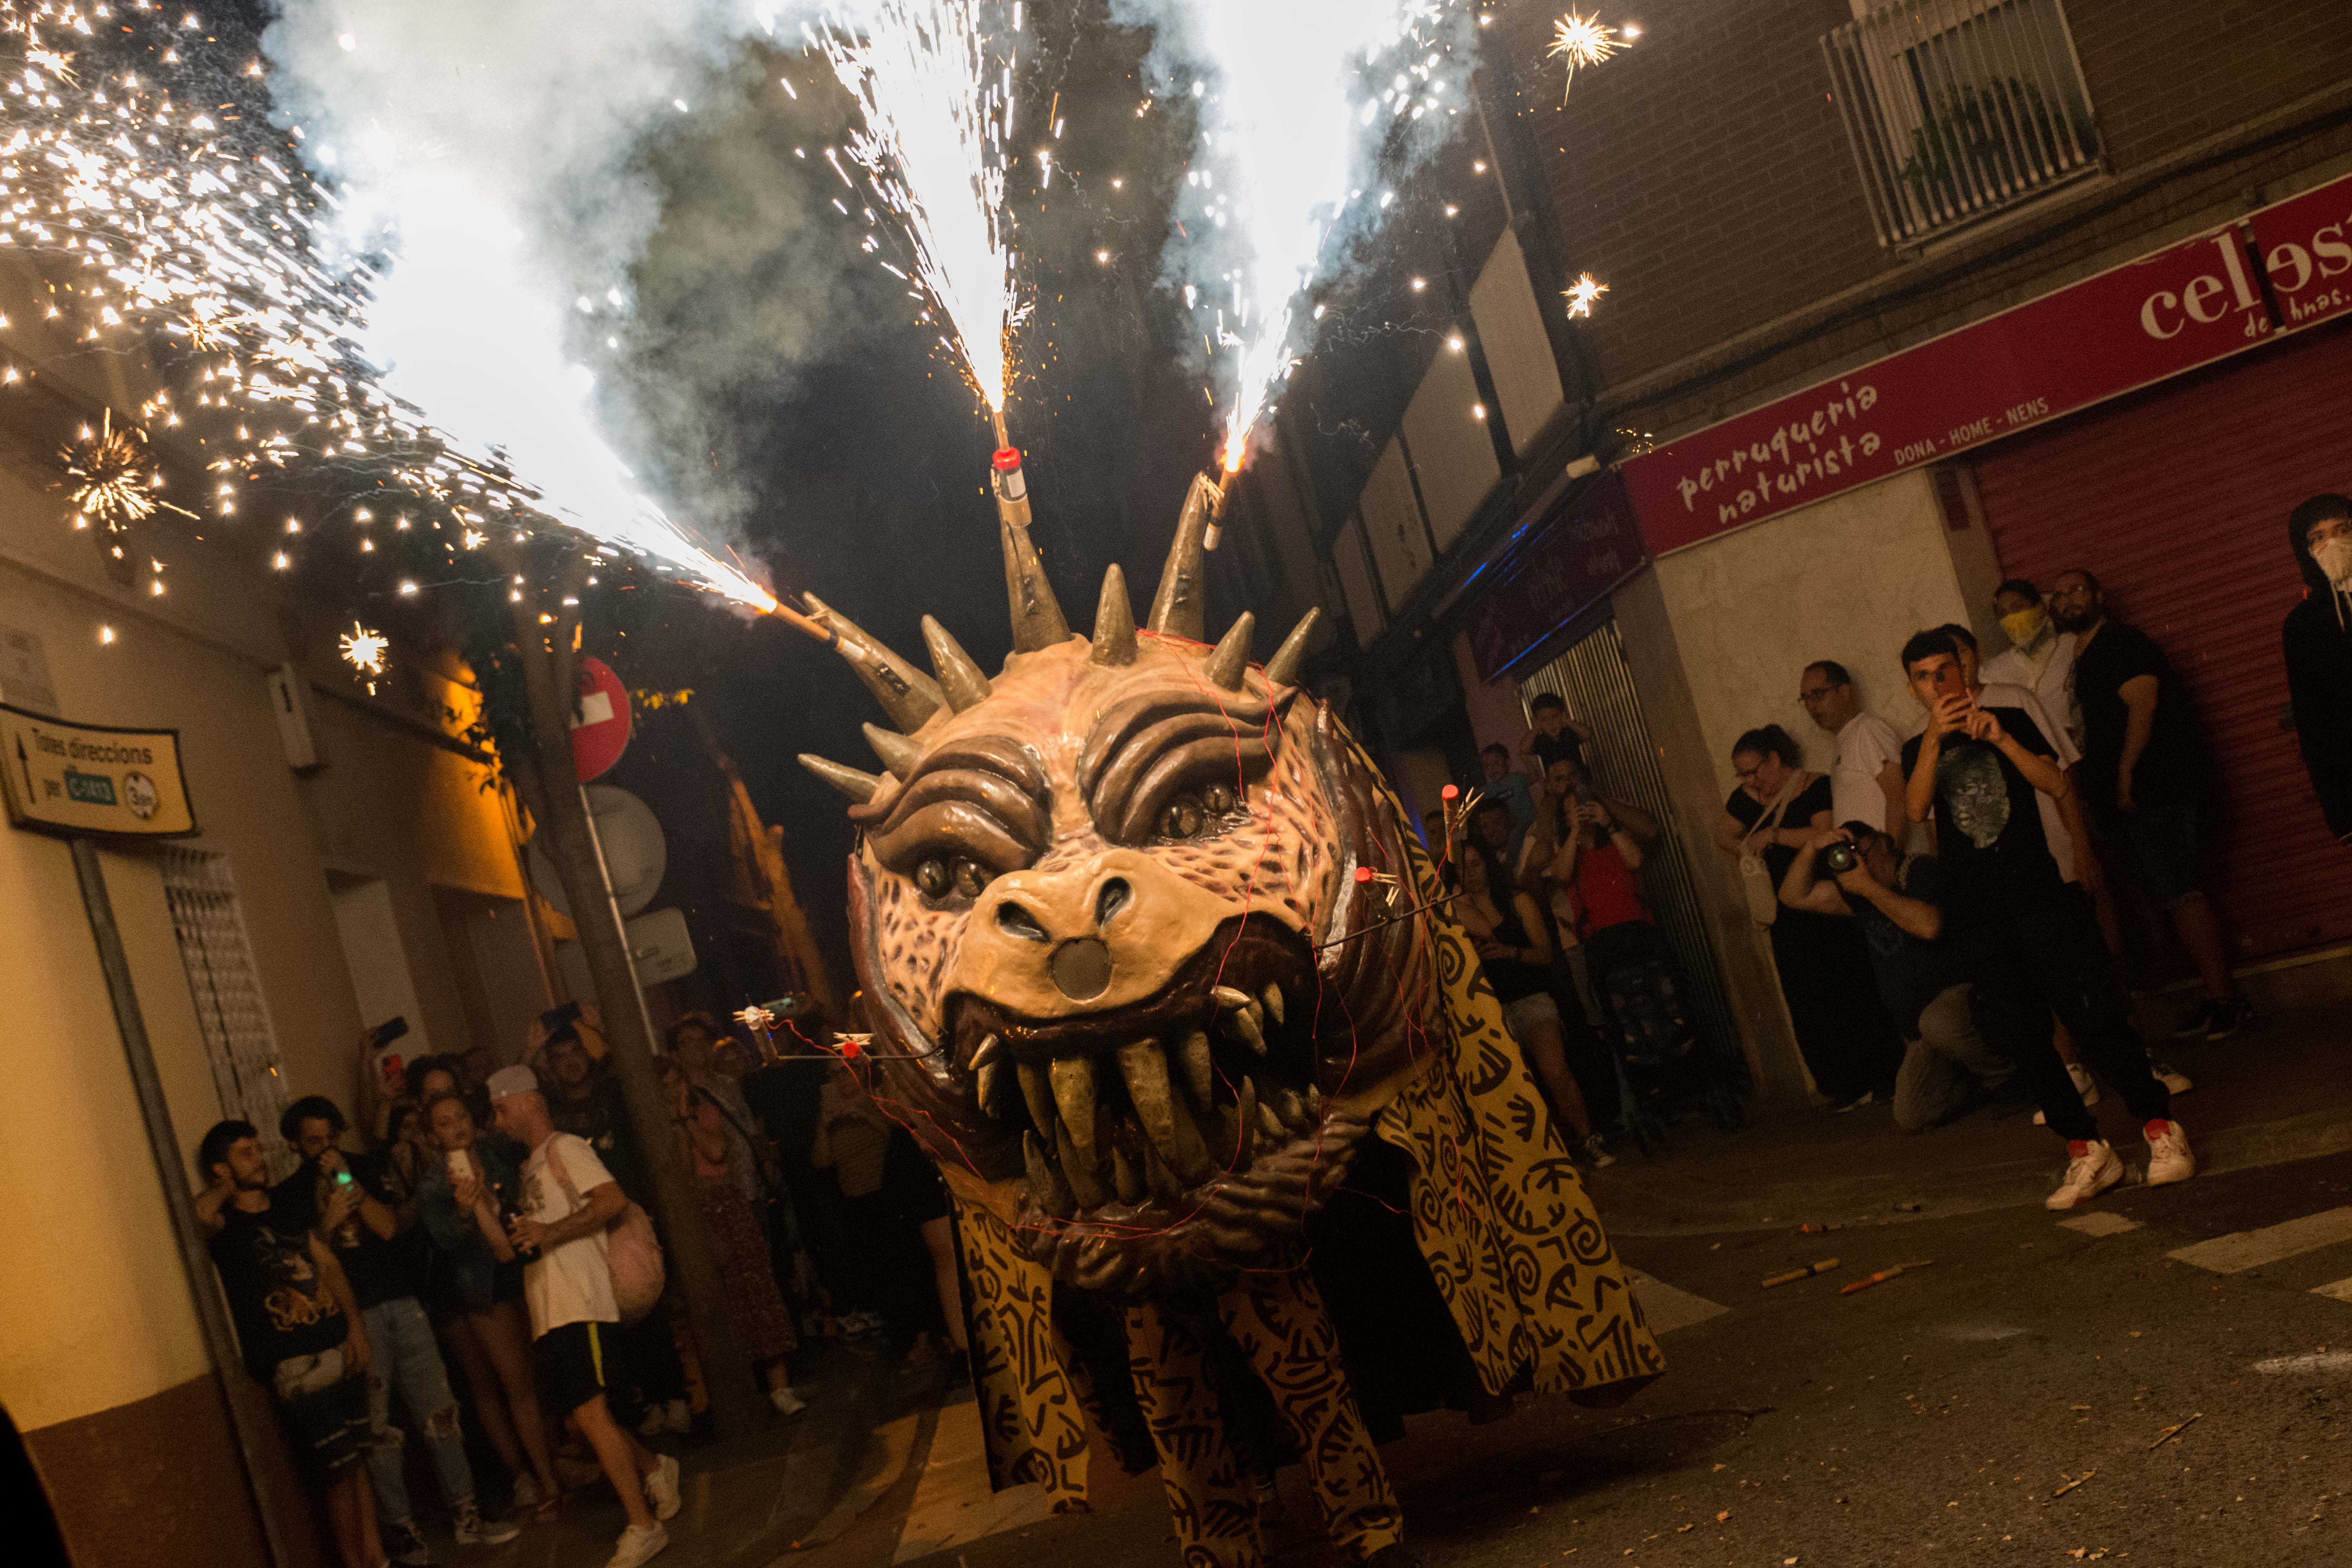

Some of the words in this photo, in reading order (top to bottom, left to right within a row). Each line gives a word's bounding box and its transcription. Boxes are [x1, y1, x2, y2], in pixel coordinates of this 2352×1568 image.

[2140, 213, 2352, 339] celes
[2244, 312, 2269, 337] de
[1677, 381, 1878, 512] perruqueria
[1719, 431, 1880, 524] naturista
[1894, 438, 1936, 466] DONA
[1949, 417, 1993, 446] HOME
[2007, 397, 2049, 426] NENS
